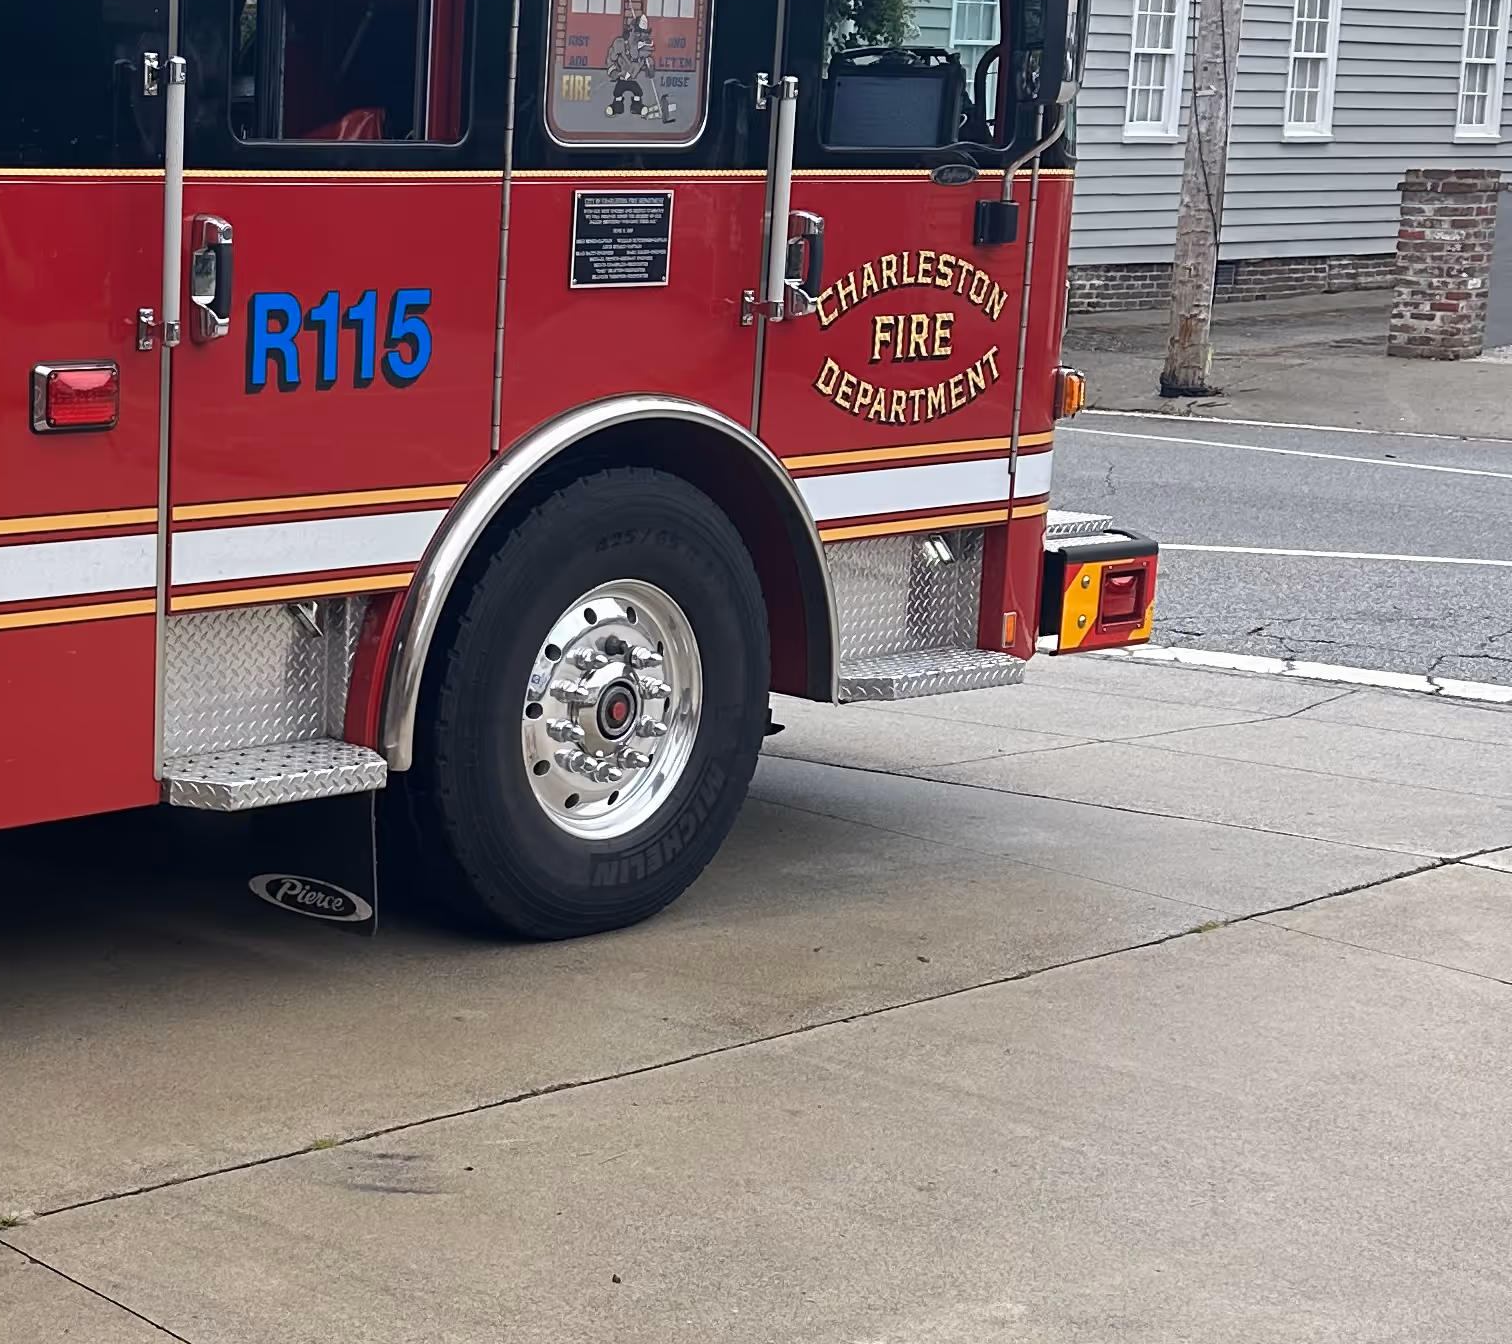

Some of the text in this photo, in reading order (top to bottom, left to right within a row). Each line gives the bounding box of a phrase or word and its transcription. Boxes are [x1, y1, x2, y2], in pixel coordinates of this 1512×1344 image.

[562, 74, 592, 101] FIRE
[660, 75, 690, 88] LOOSE
[816, 250, 1008, 330] CHARLESTON
[246, 288, 432, 395] R115
[868, 312, 955, 364] FIRE
[812, 346, 1000, 425] DEPARTMENT
[276, 878, 345, 911] Pierce
